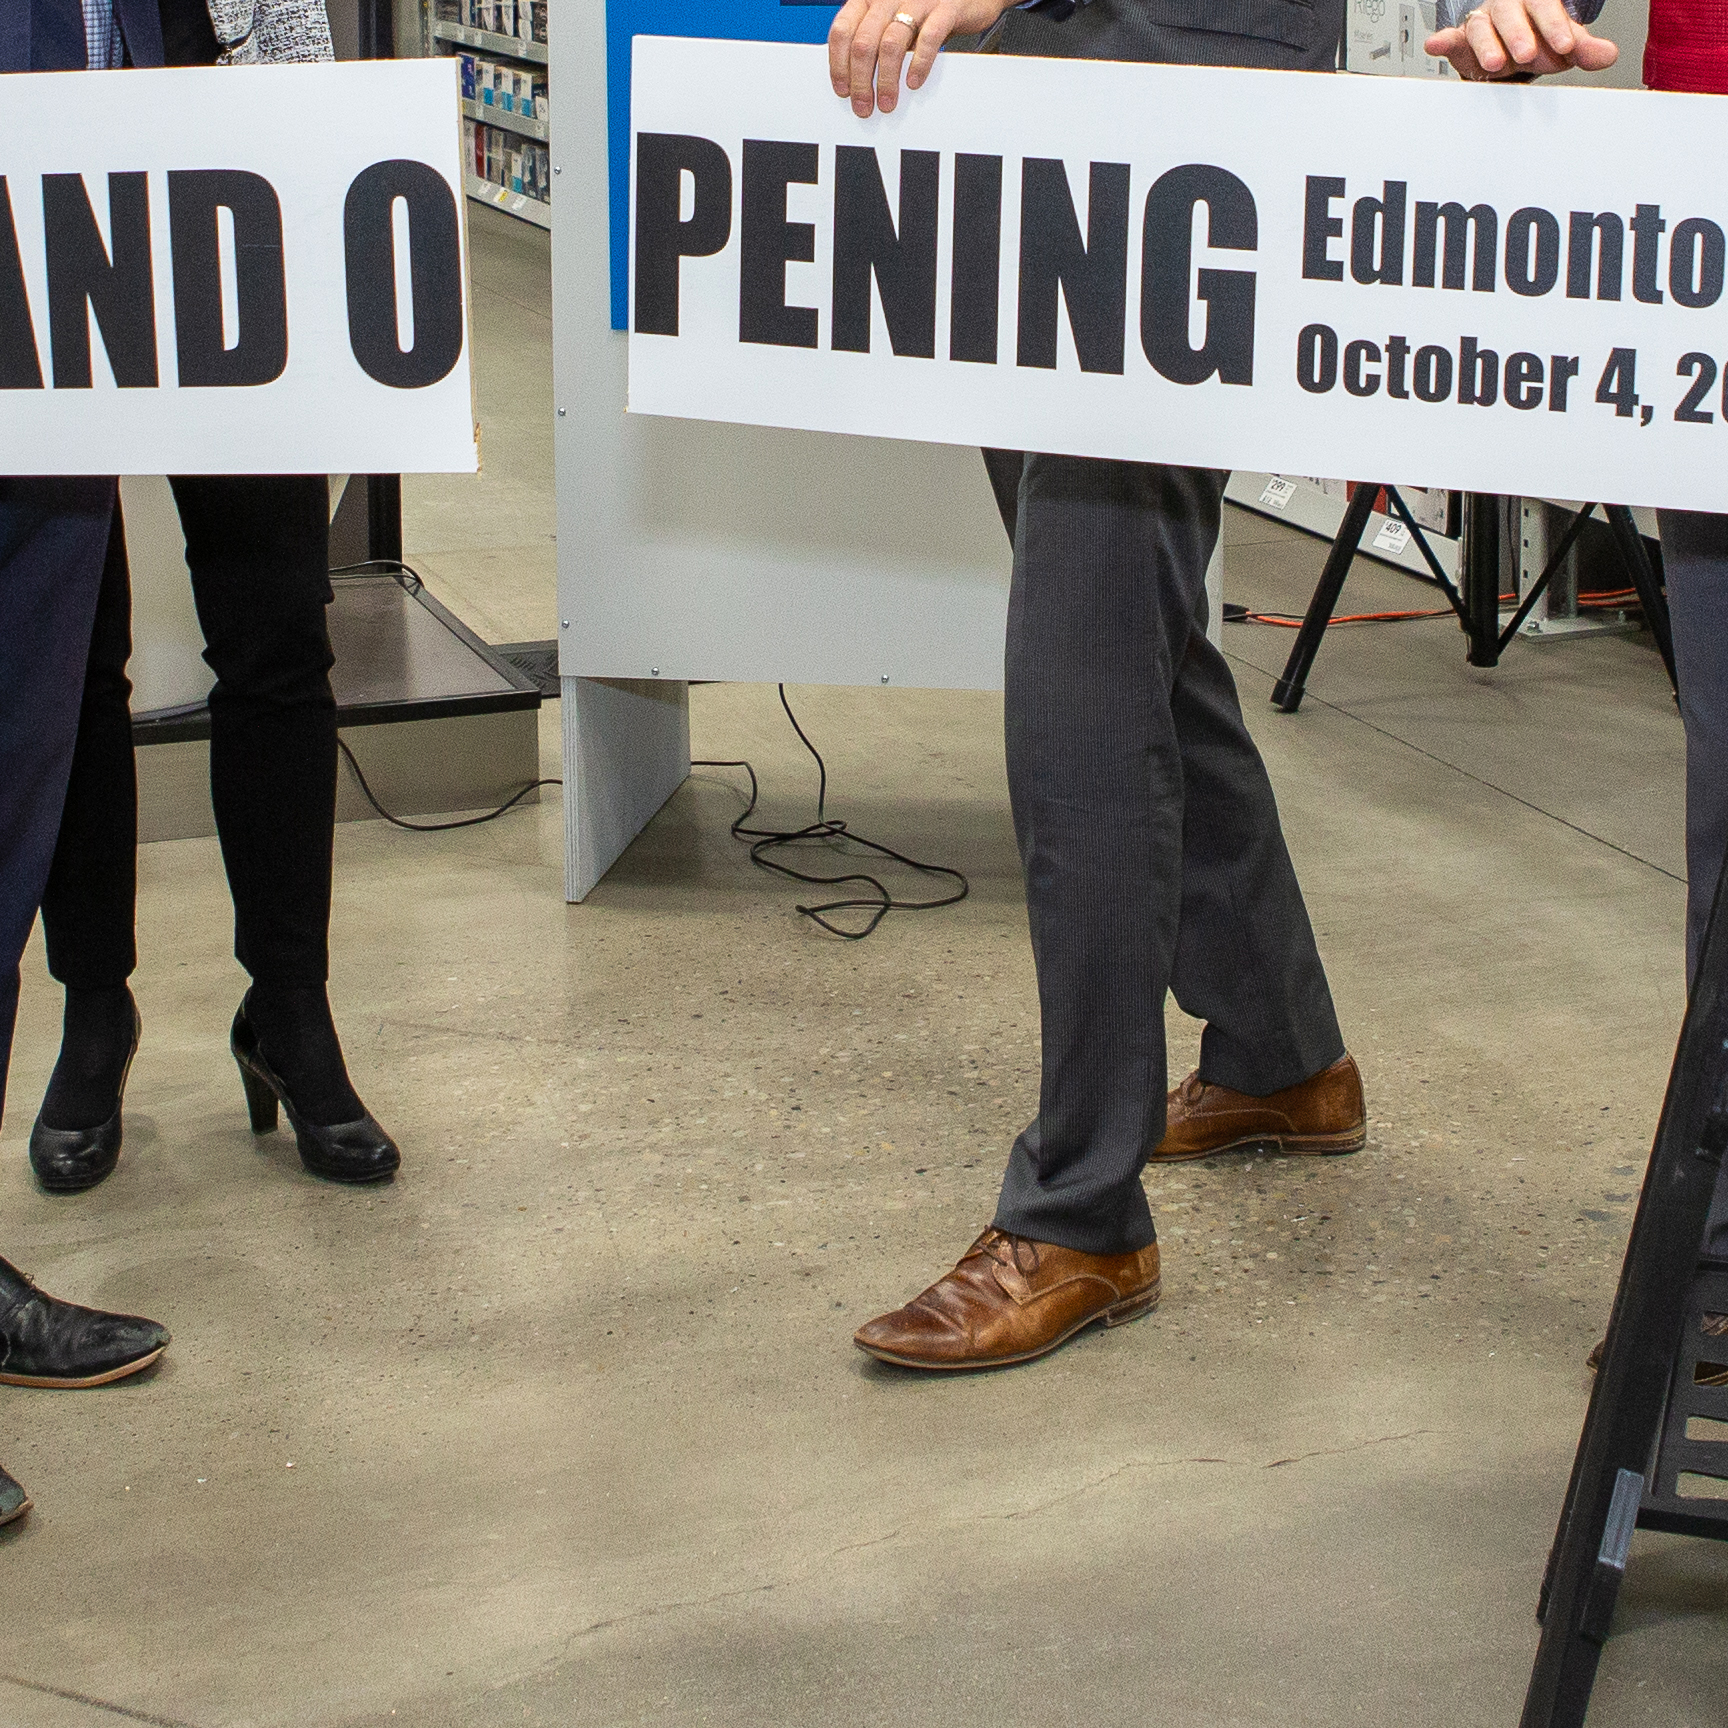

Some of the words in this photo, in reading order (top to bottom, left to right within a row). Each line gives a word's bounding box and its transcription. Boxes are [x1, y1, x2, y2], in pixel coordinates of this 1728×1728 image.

[342, 158, 463, 389] O
[634, 132, 1258, 386] PENING
[1297, 324, 1579, 412] October
[1595, 347, 1654, 427] 4,
